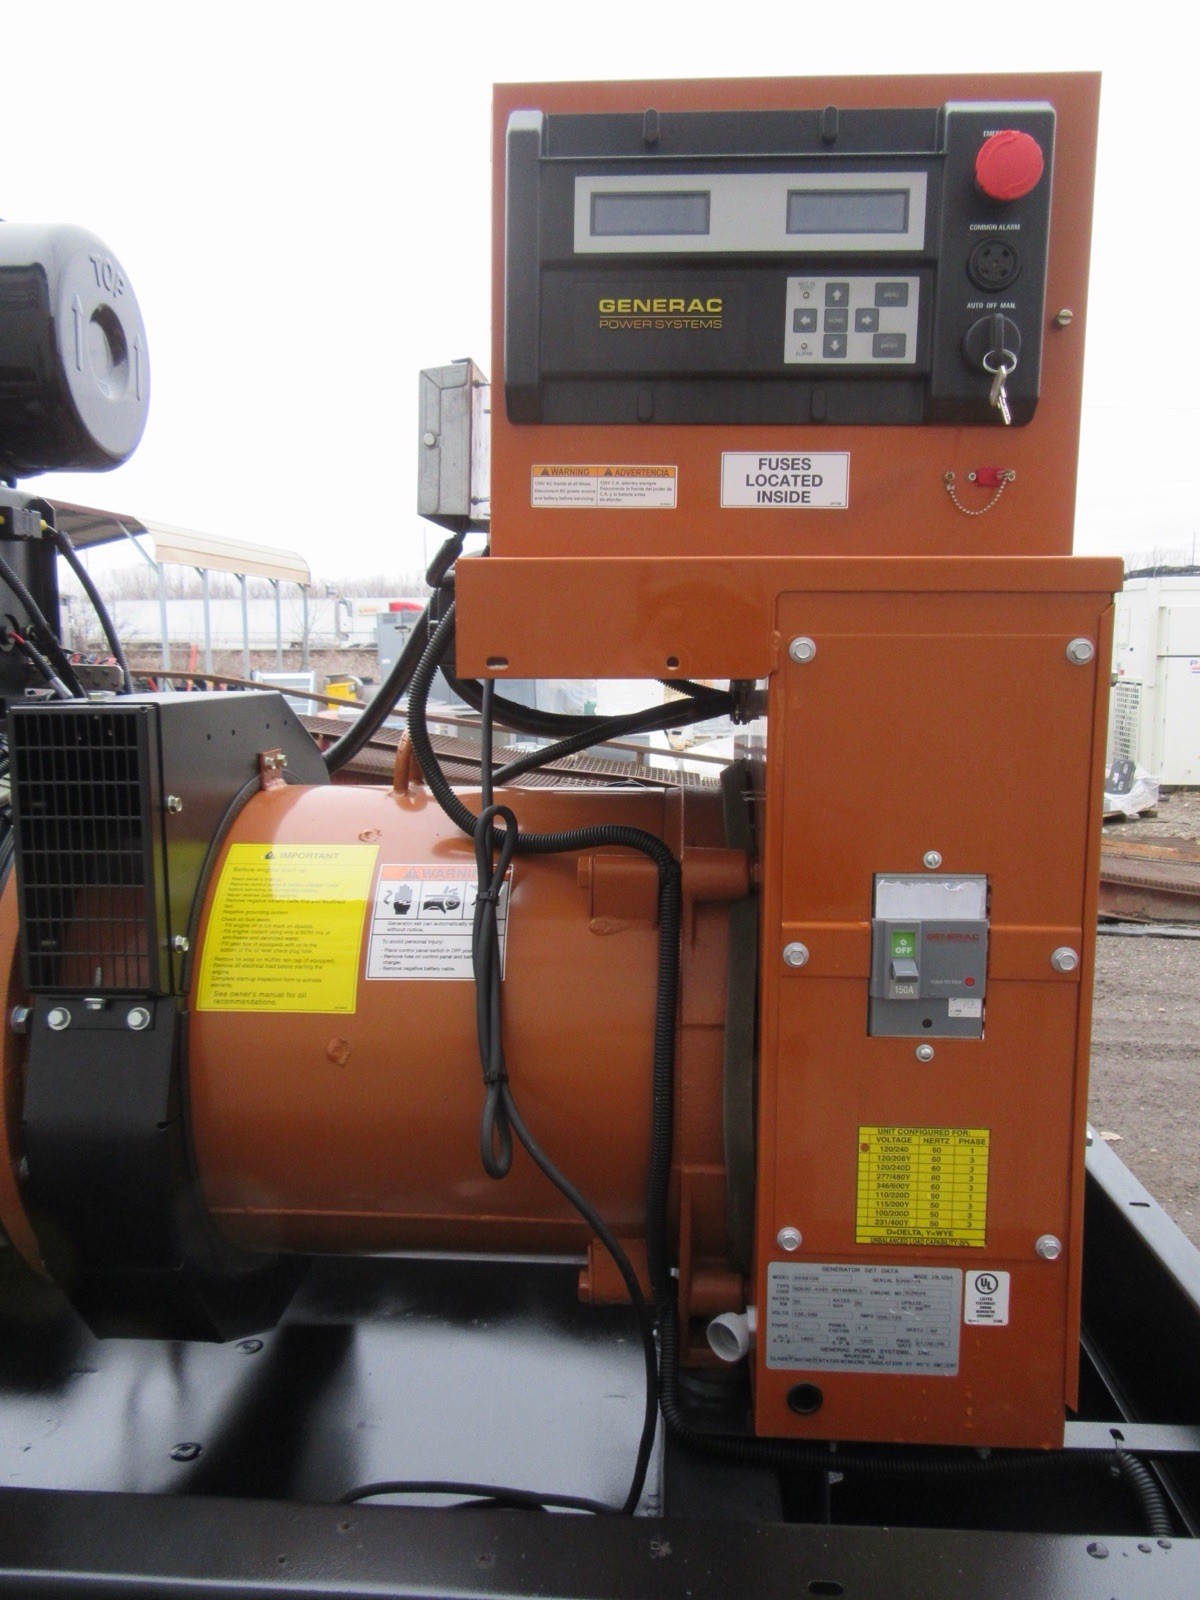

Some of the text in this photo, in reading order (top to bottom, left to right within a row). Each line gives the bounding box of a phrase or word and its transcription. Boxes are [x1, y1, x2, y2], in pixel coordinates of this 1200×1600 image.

[90, 254, 126, 297] TOP
[599, 298, 722, 313] GENERAC
[599, 320, 722, 329] POWER SYSTEMS
[758, 458, 811, 470] FUSES
[551, 468, 669, 476] WARNING ADVERTENCIA
[746, 474, 823, 487] LOCATED
[757, 491, 811, 503] INSIDE
[422, 868, 478, 879] WARNI
[927, 933, 979, 942] GENERAC
[894, 985, 914, 994] 150A
[981, 1278, 992, 1290] UL
